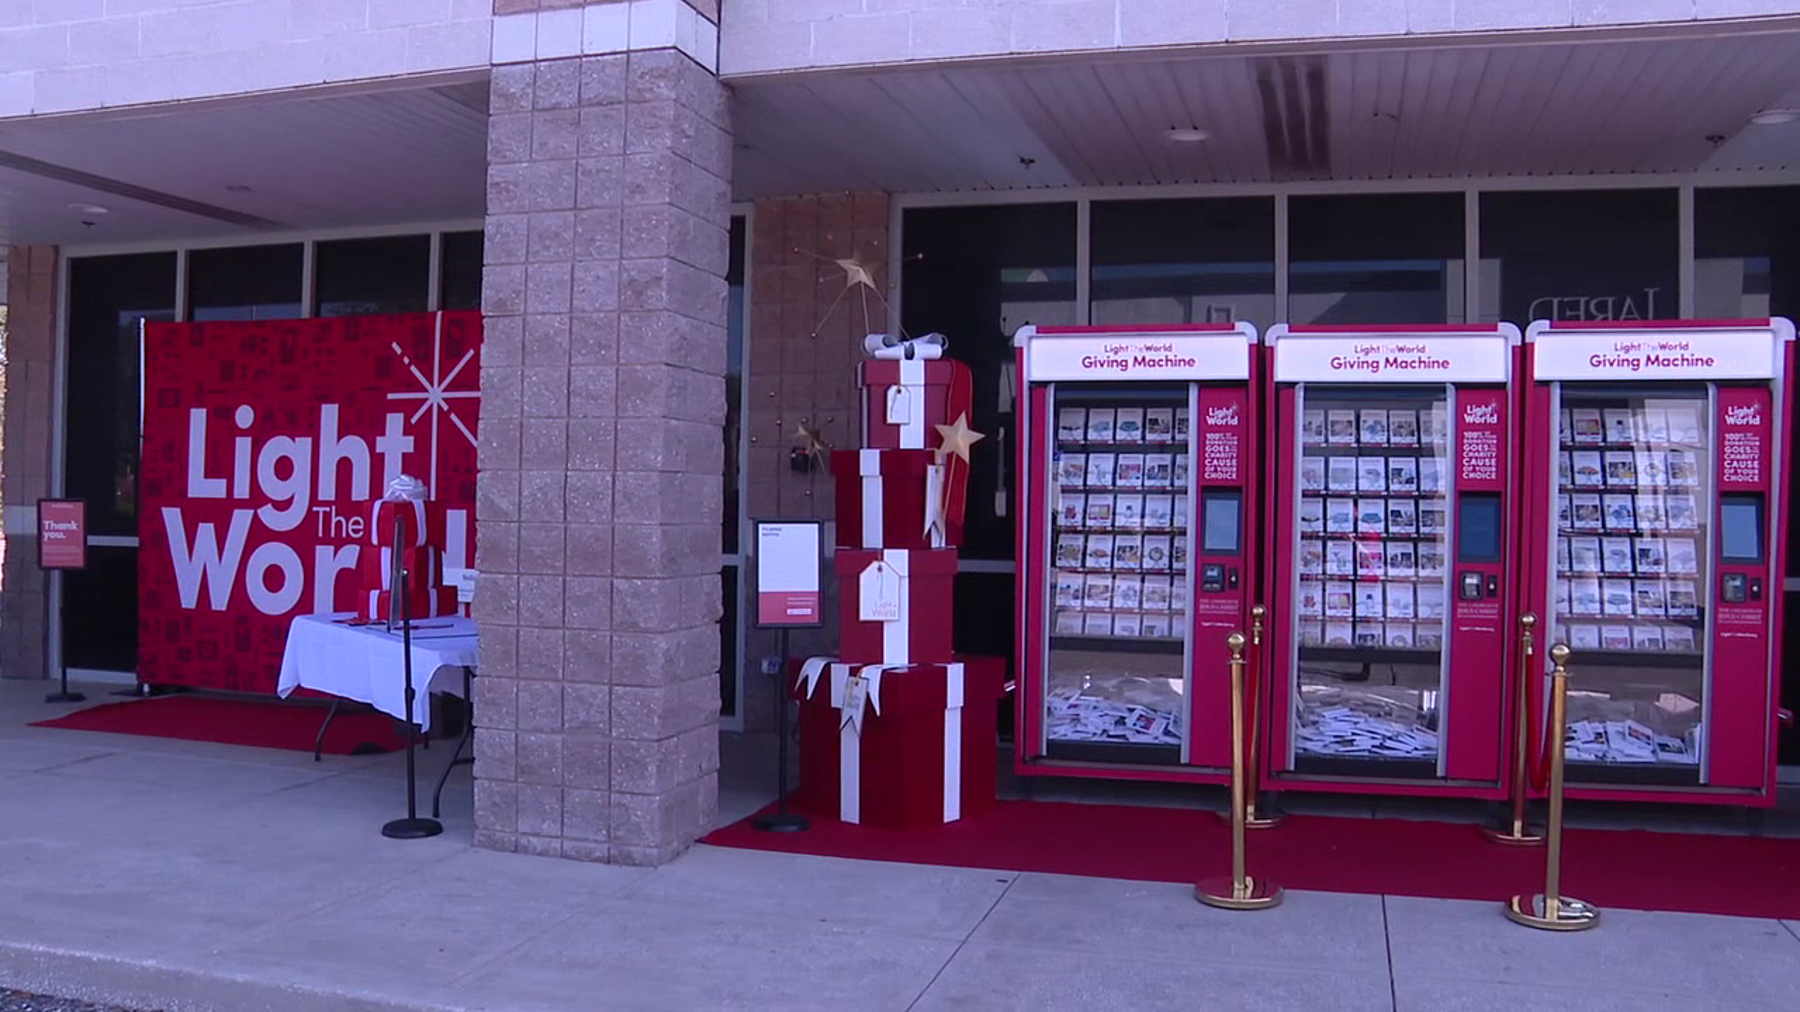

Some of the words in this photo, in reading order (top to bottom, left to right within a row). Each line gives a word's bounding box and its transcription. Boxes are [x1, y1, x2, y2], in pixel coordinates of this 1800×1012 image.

[1081, 355, 1128, 371] Giving
[1133, 354, 1196, 368] Machine
[1330, 356, 1380, 373] Giving
[1384, 355, 1450, 369] Machine
[1589, 354, 1640, 371] Giving
[1645, 353, 1715, 368] Machine
[1208, 407, 1233, 417] Light
[1466, 405, 1492, 415] Light
[1727, 406, 1755, 416] Light
[1205, 415, 1238, 425] World
[1463, 413, 1498, 424] World
[1724, 415, 1761, 425] World
[1724, 446, 1751, 454] GOES
[187, 403, 415, 532] Light
[1723, 460, 1760, 468] CAUSE
[42, 520, 79, 530] Thank
[312, 505, 365, 539] The
